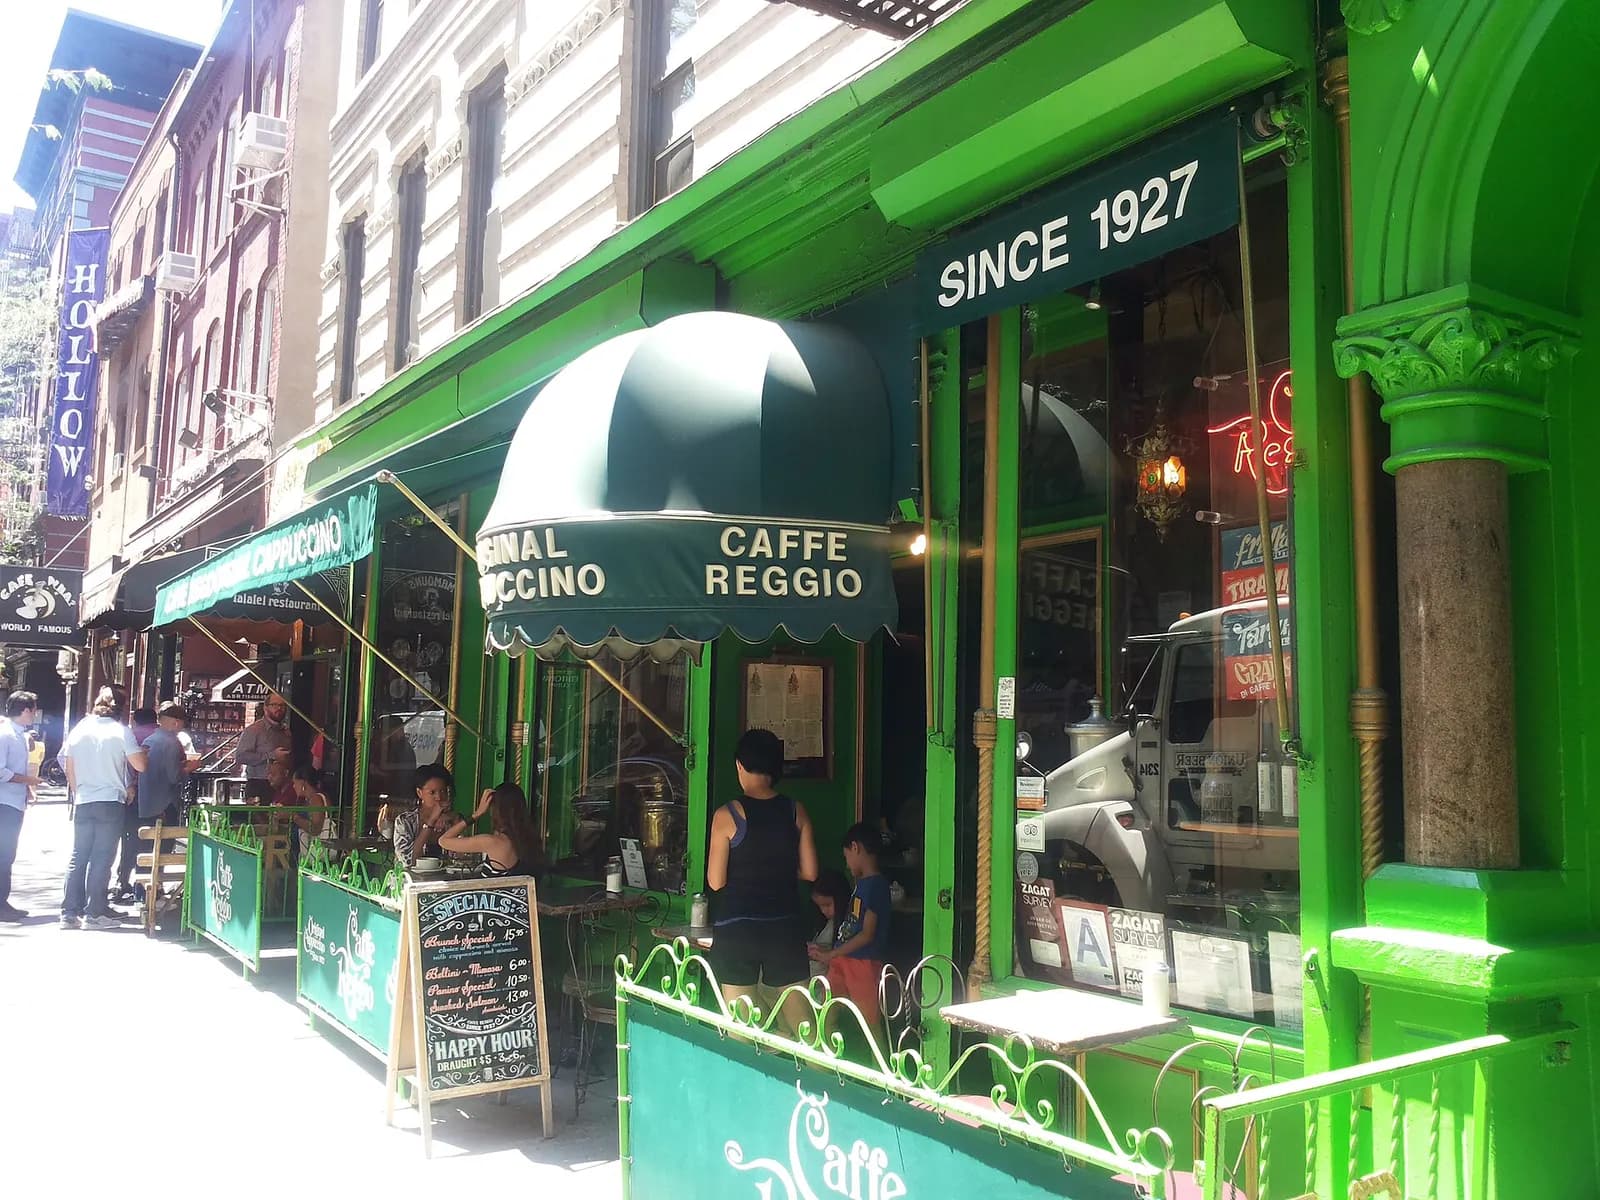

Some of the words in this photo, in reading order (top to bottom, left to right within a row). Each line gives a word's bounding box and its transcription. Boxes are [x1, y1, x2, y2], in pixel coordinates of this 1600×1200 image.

[937, 215, 1069, 308] SINCE
[1090, 159, 1199, 250] 1927
[55, 264, 97, 478] HOLLOW
[252, 514, 342, 577] CAPPUCCINO
[719, 526, 849, 563] CAFFE
[706, 563, 863, 598] REGGIO
[0, 622, 32, 632] WORLD
[38, 625, 73, 634] FAMOUS
[232, 683, 270, 694] ATM
[1021, 883, 1051, 897] ZAGAT
[1023, 894, 1054, 908] SURVEY
[1111, 913, 1161, 933] ZAGAT
[1076, 916, 1108, 968] A
[1112, 928, 1162, 949] SURVEY
[424, 966, 461, 981] Bellini
[469, 962, 503, 975] Mimosa
[461, 978, 497, 997] Special
[465, 995, 500, 1011] Salmon
[434, 1035, 488, 1061] HAPPY
[491, 1029, 534, 1053] HOUR
[437, 1057, 478, 1072] DRAUGHT
[480, 1054, 492, 1065] $5
